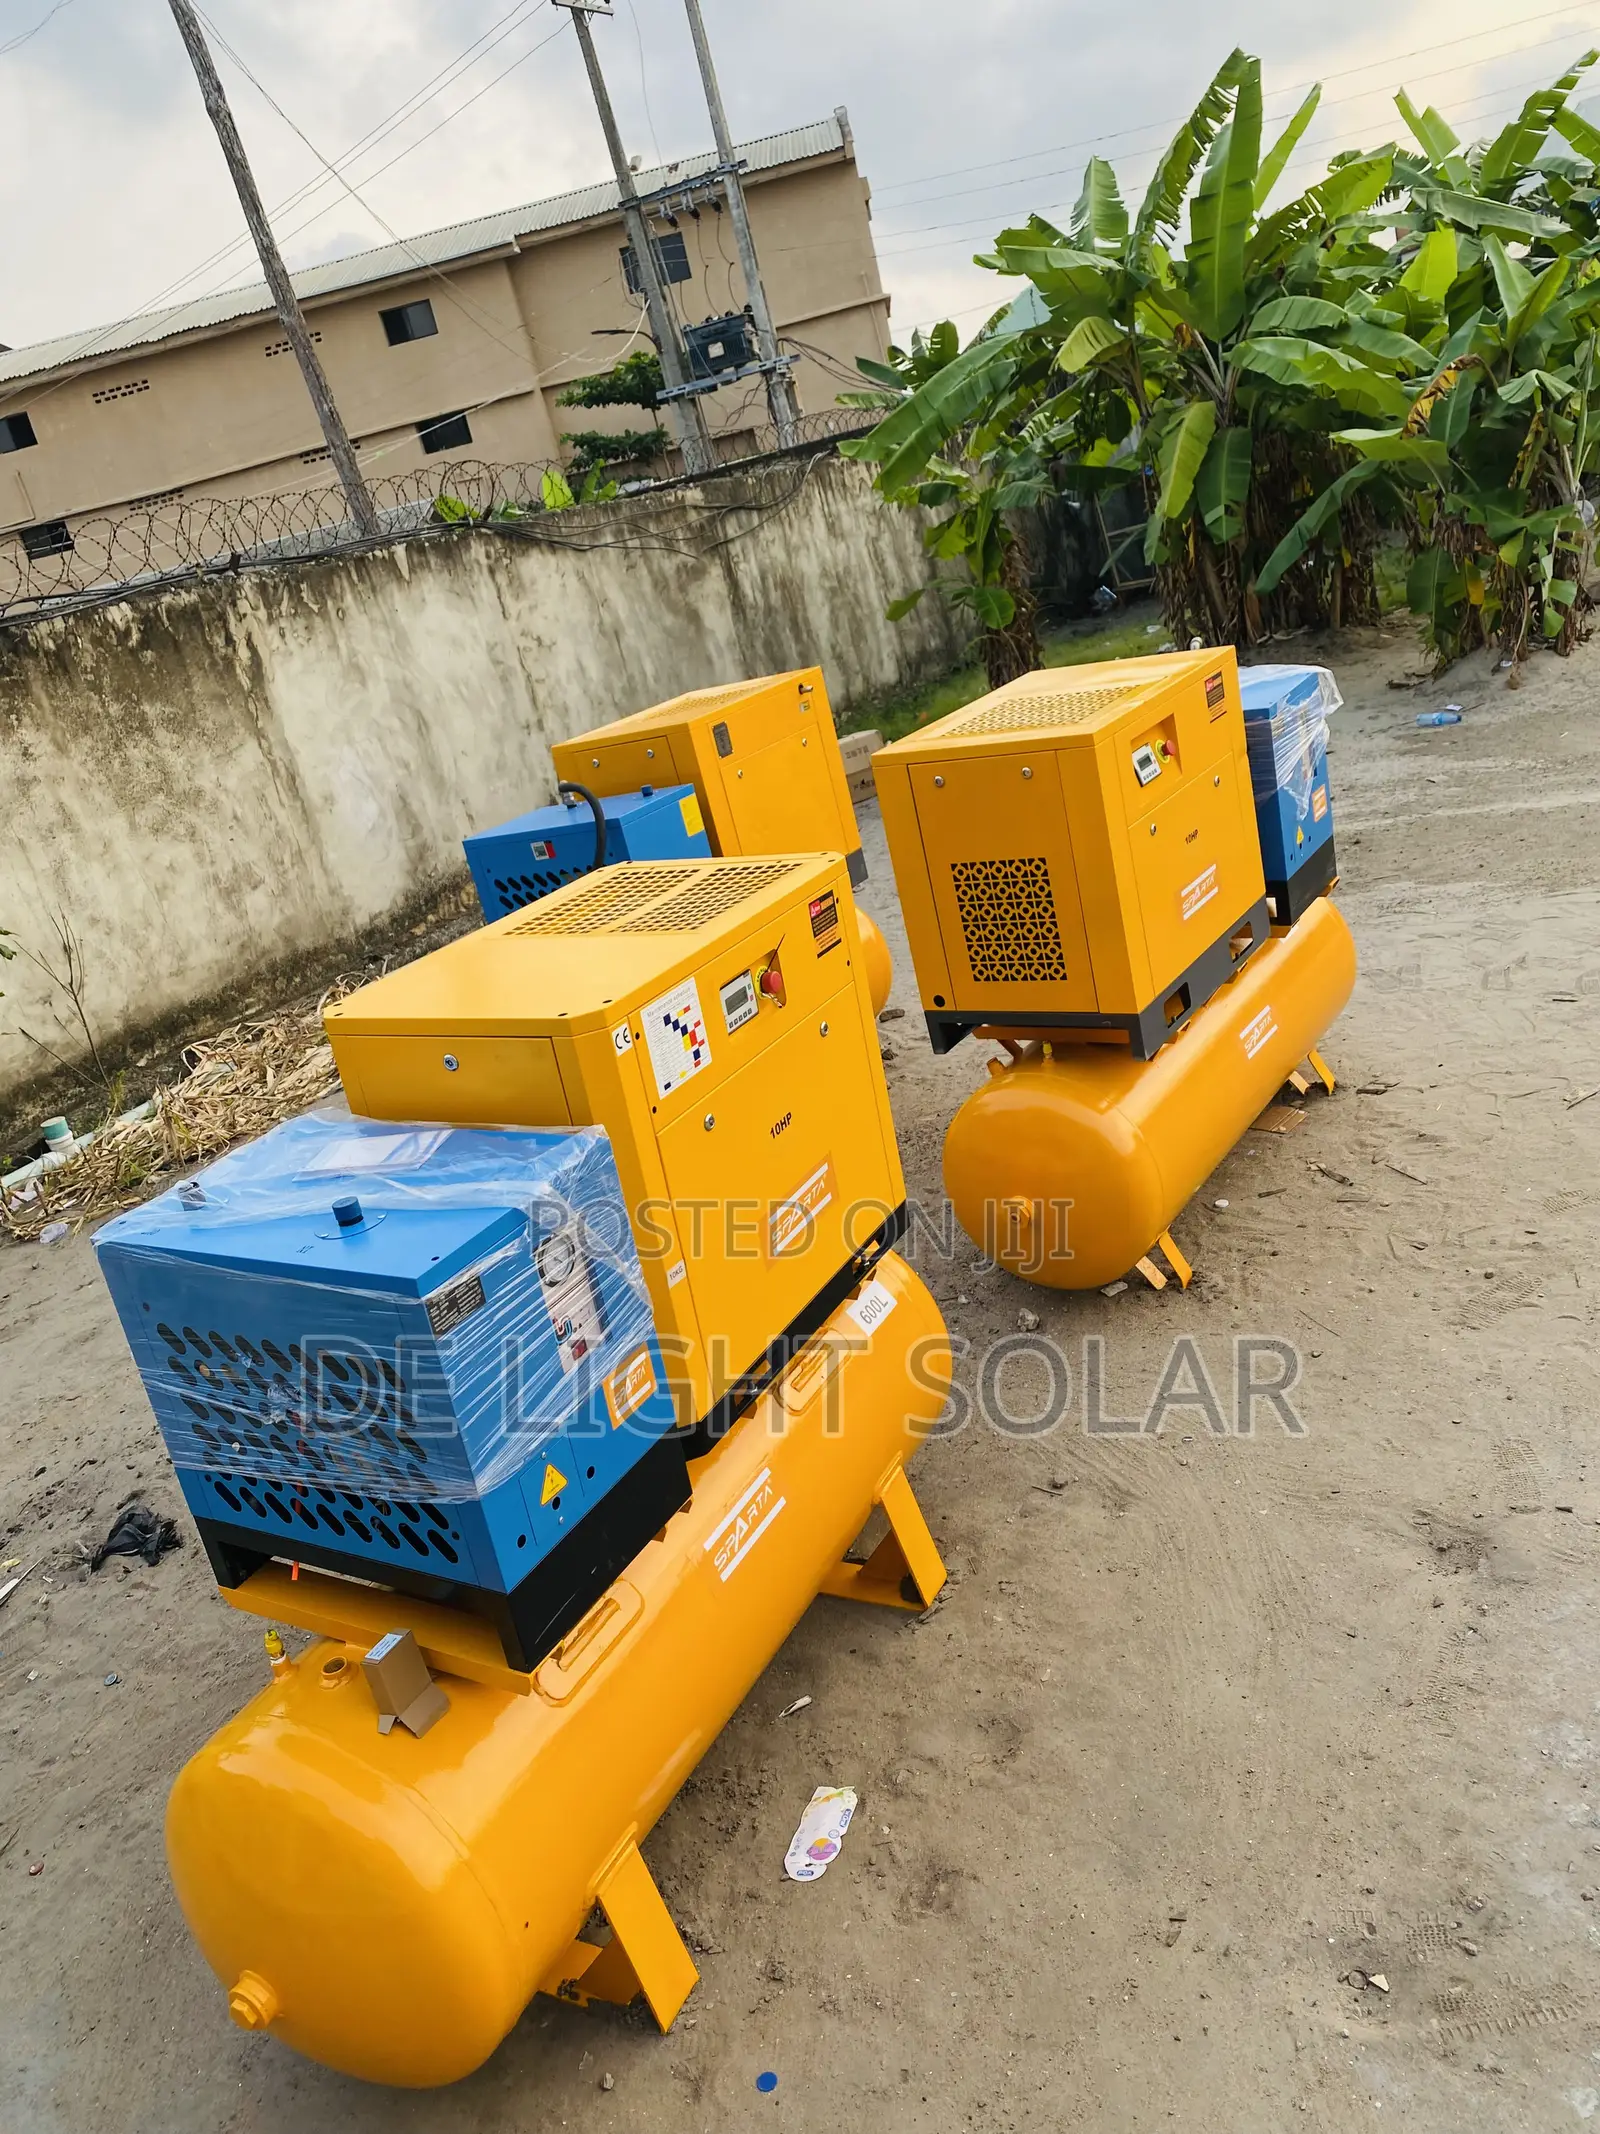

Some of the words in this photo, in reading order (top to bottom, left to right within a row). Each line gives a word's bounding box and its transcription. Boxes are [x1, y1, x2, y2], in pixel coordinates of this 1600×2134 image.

[1184, 828, 1199, 845] 10HP
[615, 1027, 631, 1050] CE
[769, 1111, 792, 1140] 10HP
[771, 1177, 826, 1245] SPARTA
[668, 1264, 684, 1281] 10KG
[858, 1294, 889, 1325] 600L
[614, 1365, 646, 1406] SPARTA
[713, 1484, 773, 1572] SPARTA
